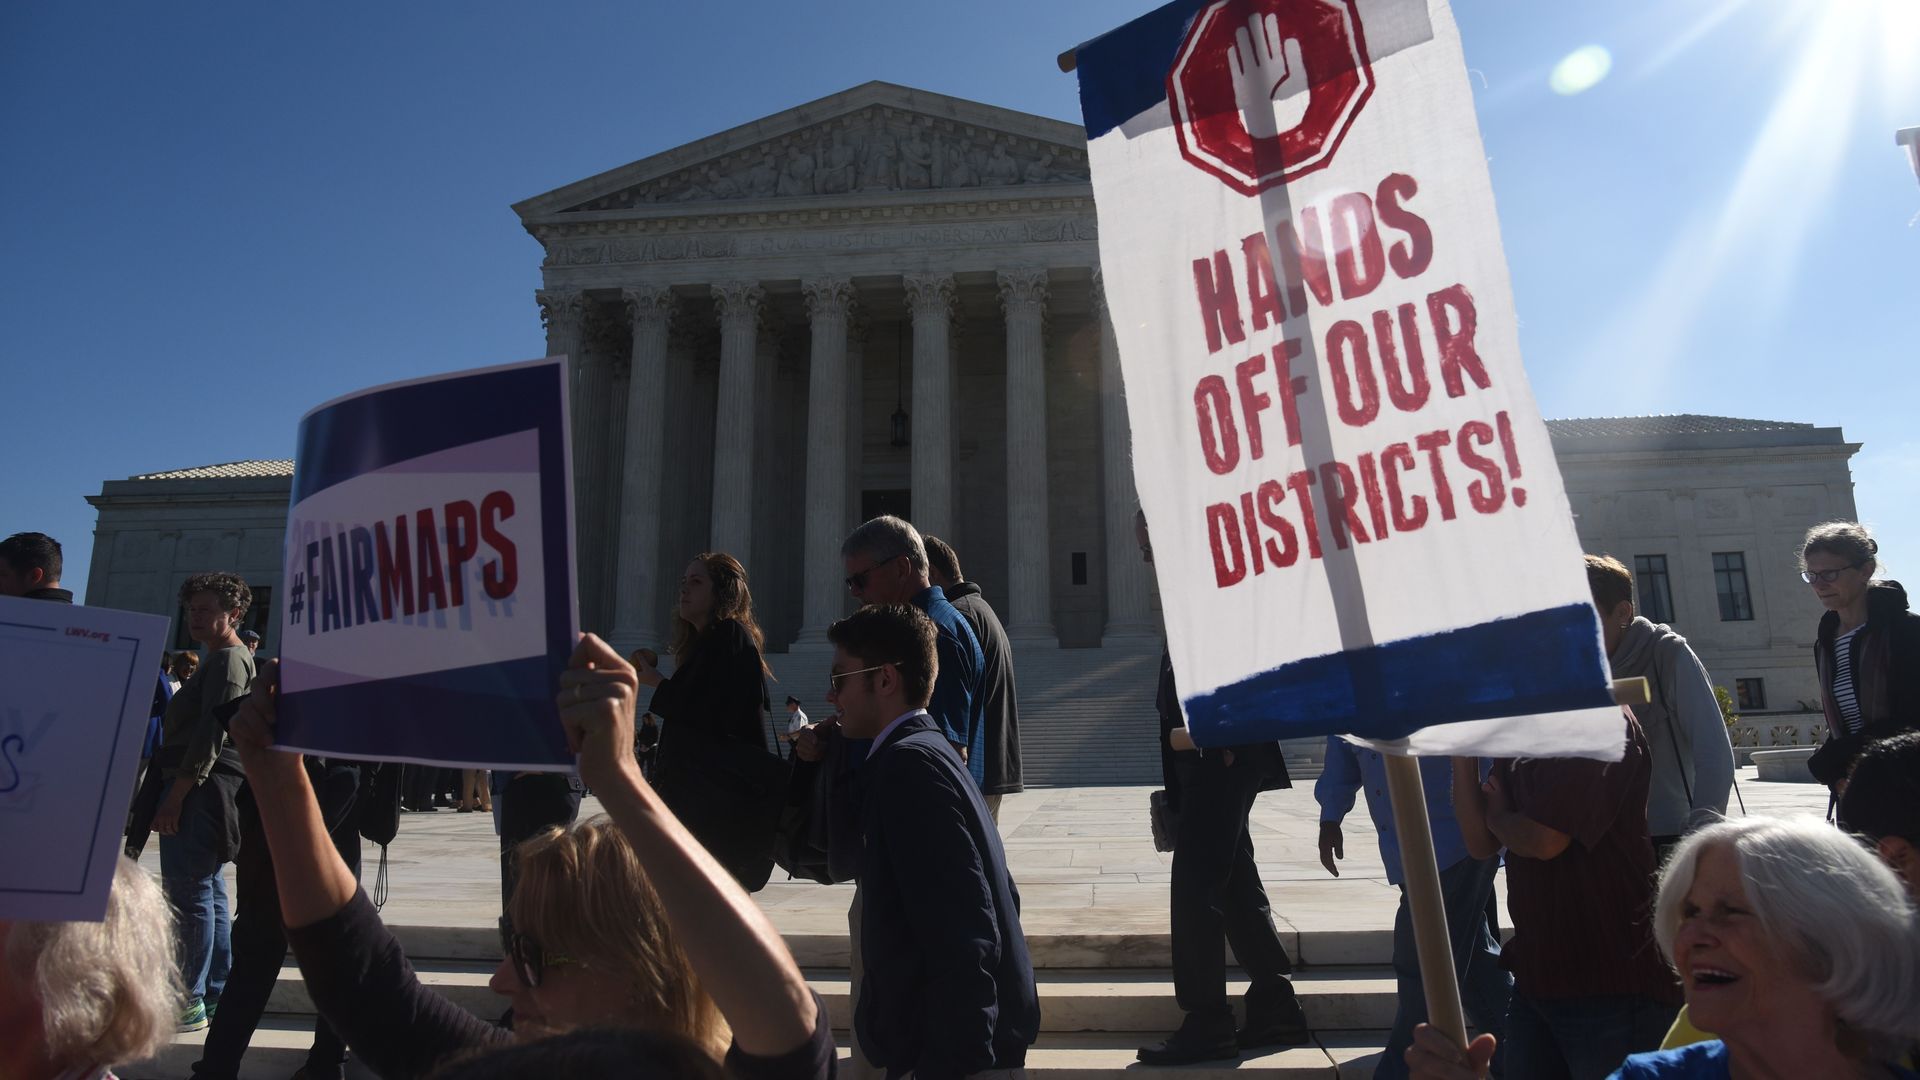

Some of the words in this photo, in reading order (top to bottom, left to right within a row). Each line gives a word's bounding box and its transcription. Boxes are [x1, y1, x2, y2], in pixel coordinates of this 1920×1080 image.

[900, 228, 965, 245] UNDER
[971, 226, 1009, 241] LAW
[1192, 172, 1434, 355] HANDS
[1193, 337, 1308, 476] OFF
[1325, 282, 1492, 428] OUR
[289, 490, 519, 636] #FAIRMAPS
[1205, 410, 1528, 589] DISTRICTS!
[65, 626, 111, 642] LWV.org
